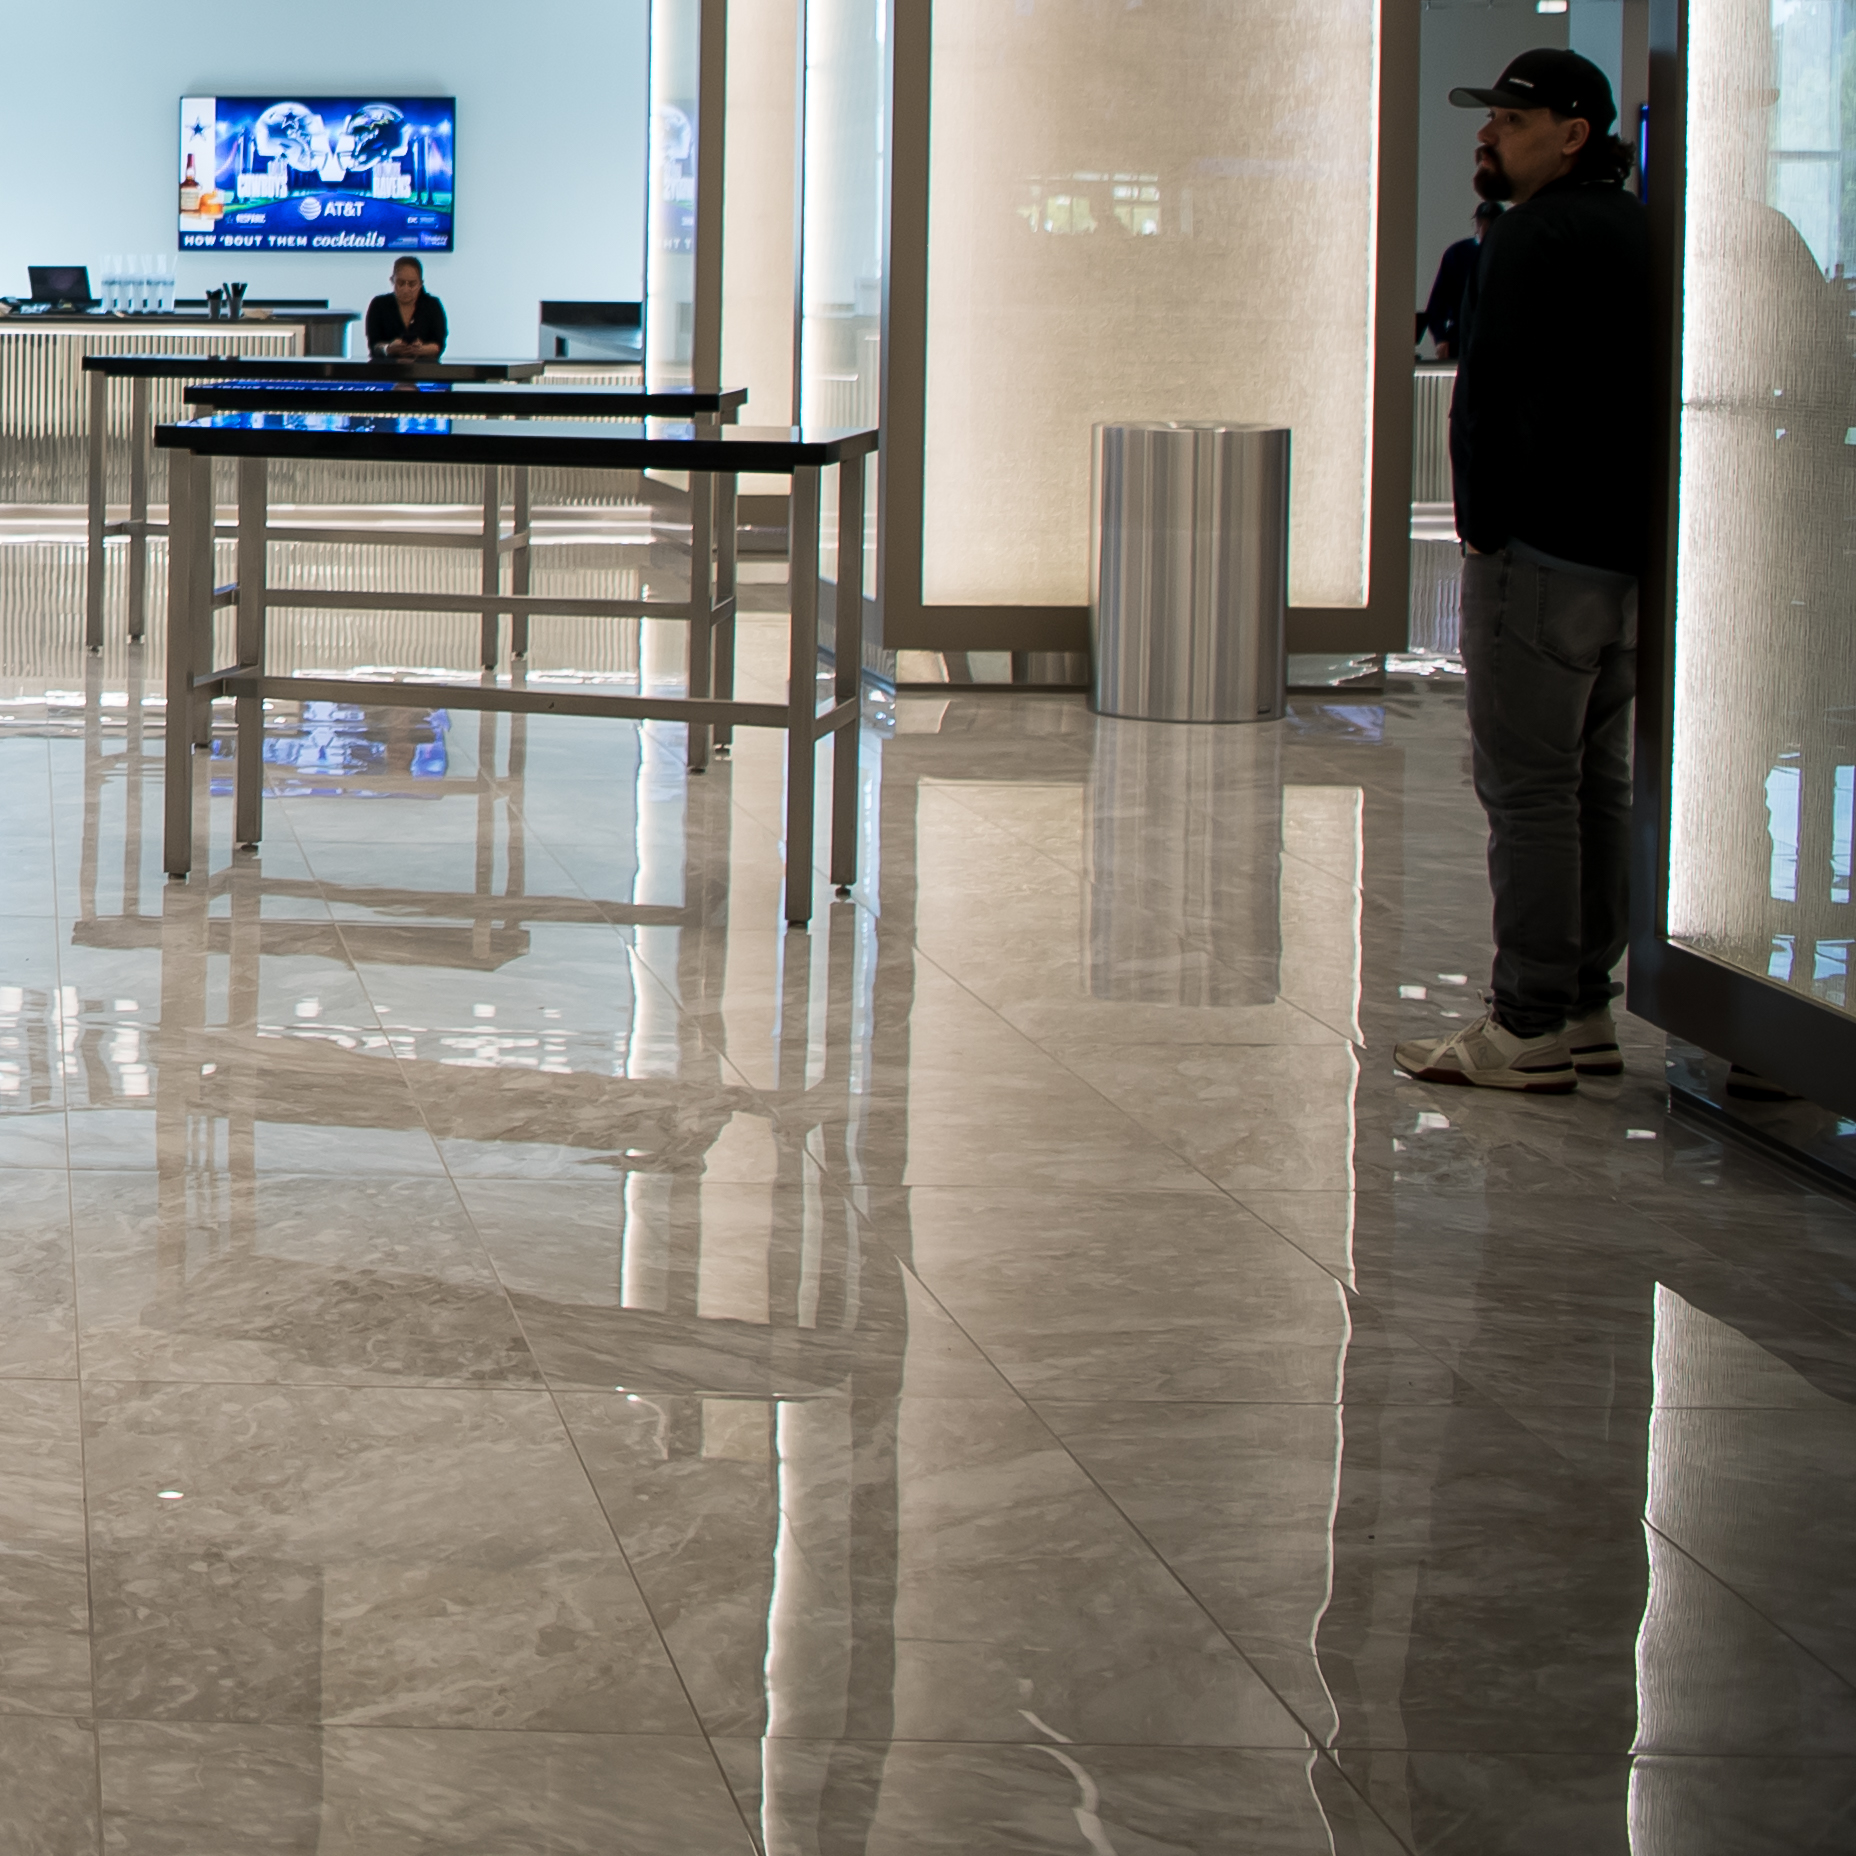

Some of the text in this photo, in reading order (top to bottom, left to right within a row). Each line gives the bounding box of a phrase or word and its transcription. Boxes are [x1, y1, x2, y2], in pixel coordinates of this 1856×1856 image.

[324, 201, 365, 217] AT&T
[184, 235, 216, 246] HOW
[219, 235, 263, 246] 'BOUT
[268, 235, 308, 246] THEM
[312, 230, 386, 248] cocktails
